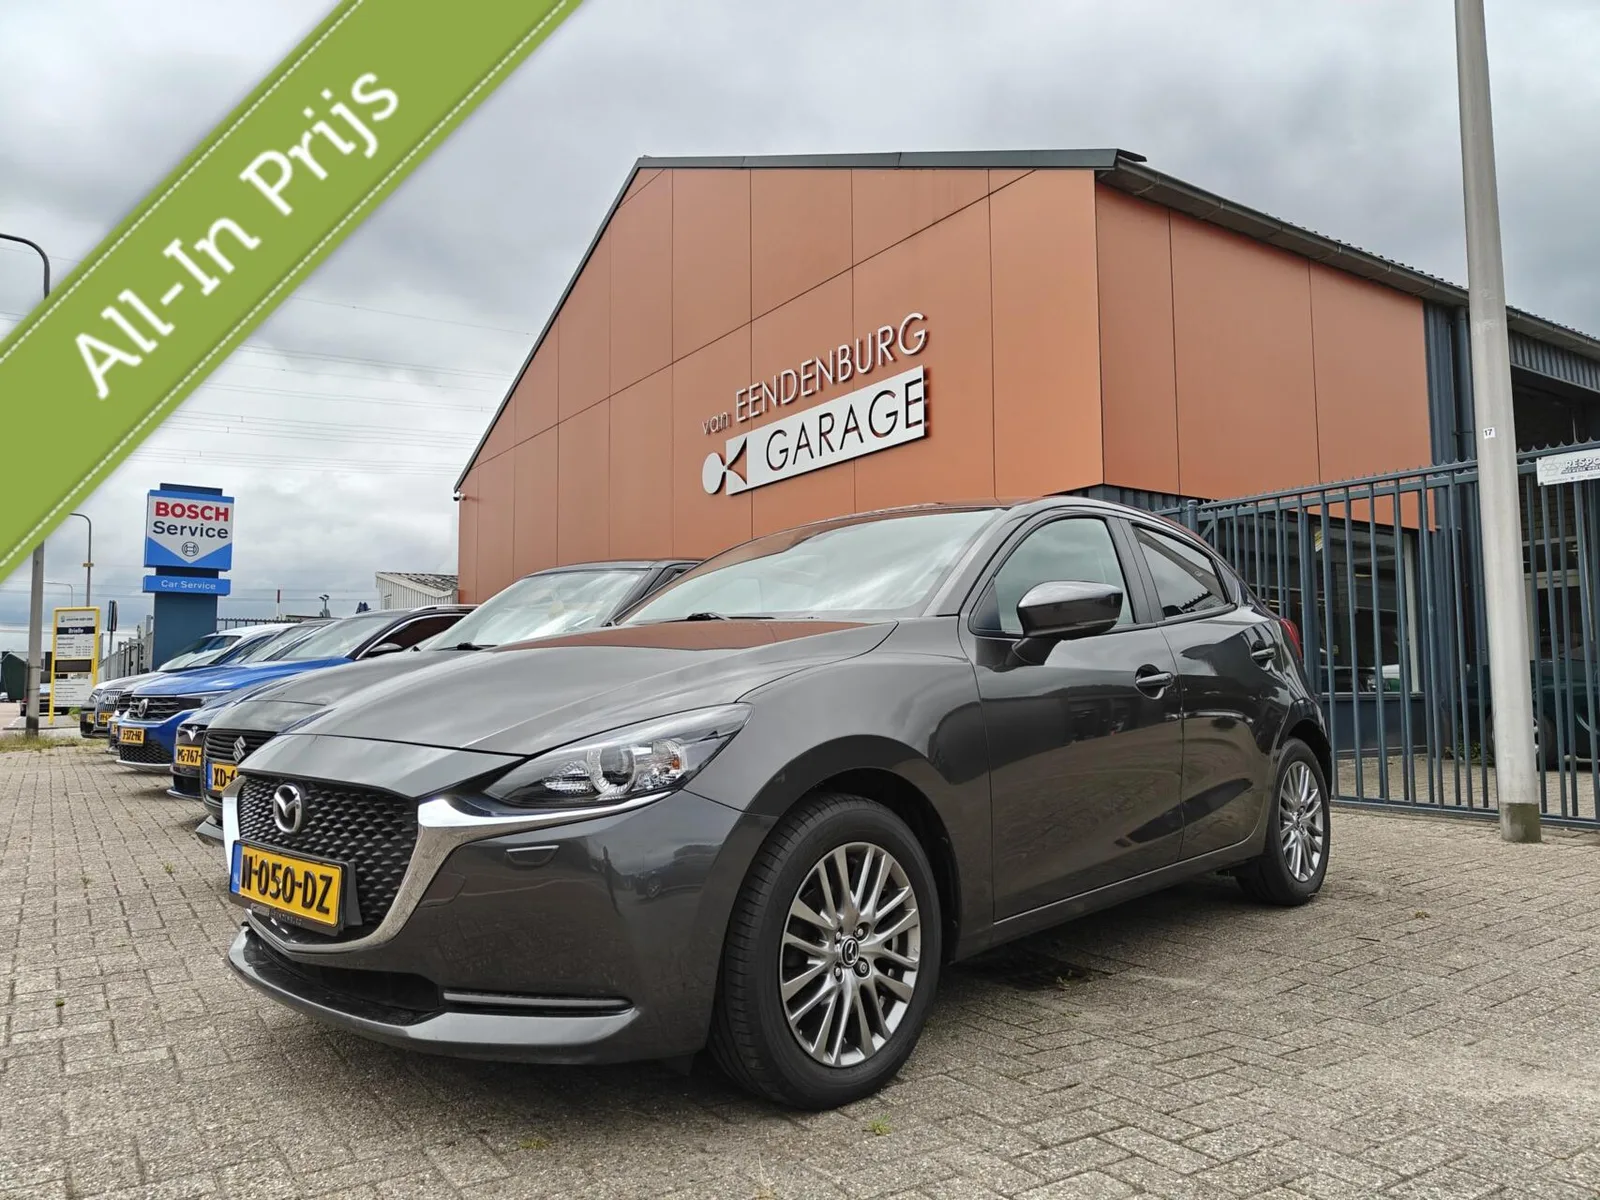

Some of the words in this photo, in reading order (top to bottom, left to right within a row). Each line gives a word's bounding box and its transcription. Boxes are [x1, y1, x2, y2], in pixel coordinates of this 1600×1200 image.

[702, 411, 731, 435] van
[736, 312, 929, 423] EENDENBURG
[766, 377, 923, 472] GARAGE
[1484, 428, 1493, 437] 17
[155, 501, 230, 522] BOSCH
[153, 520, 229, 539] Service
[161, 580, 180, 588] Car
[181, 580, 217, 590] Service
[241, 854, 333, 915] N-050-DZ
